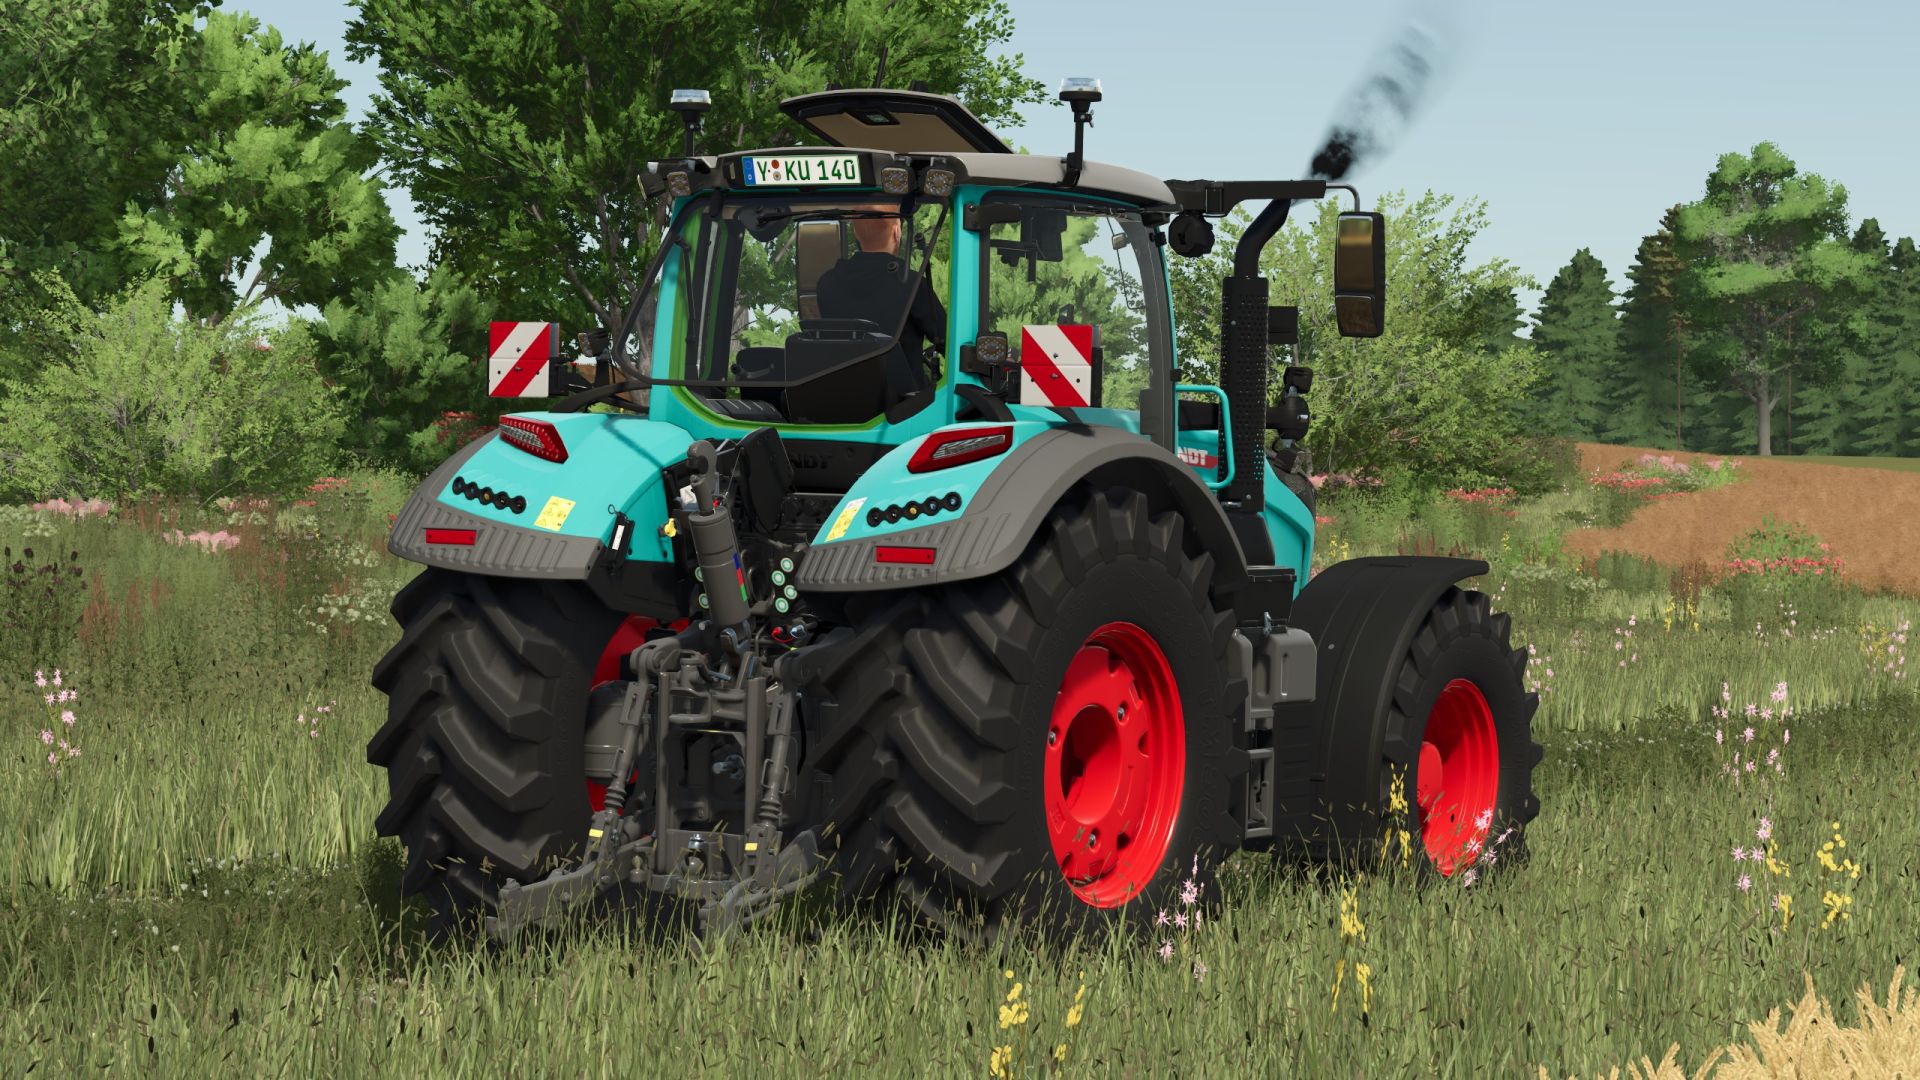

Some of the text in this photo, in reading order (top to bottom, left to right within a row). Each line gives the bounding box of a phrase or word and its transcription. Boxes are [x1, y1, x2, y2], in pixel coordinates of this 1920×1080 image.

[757, 160, 856, 181] Y KU 140
